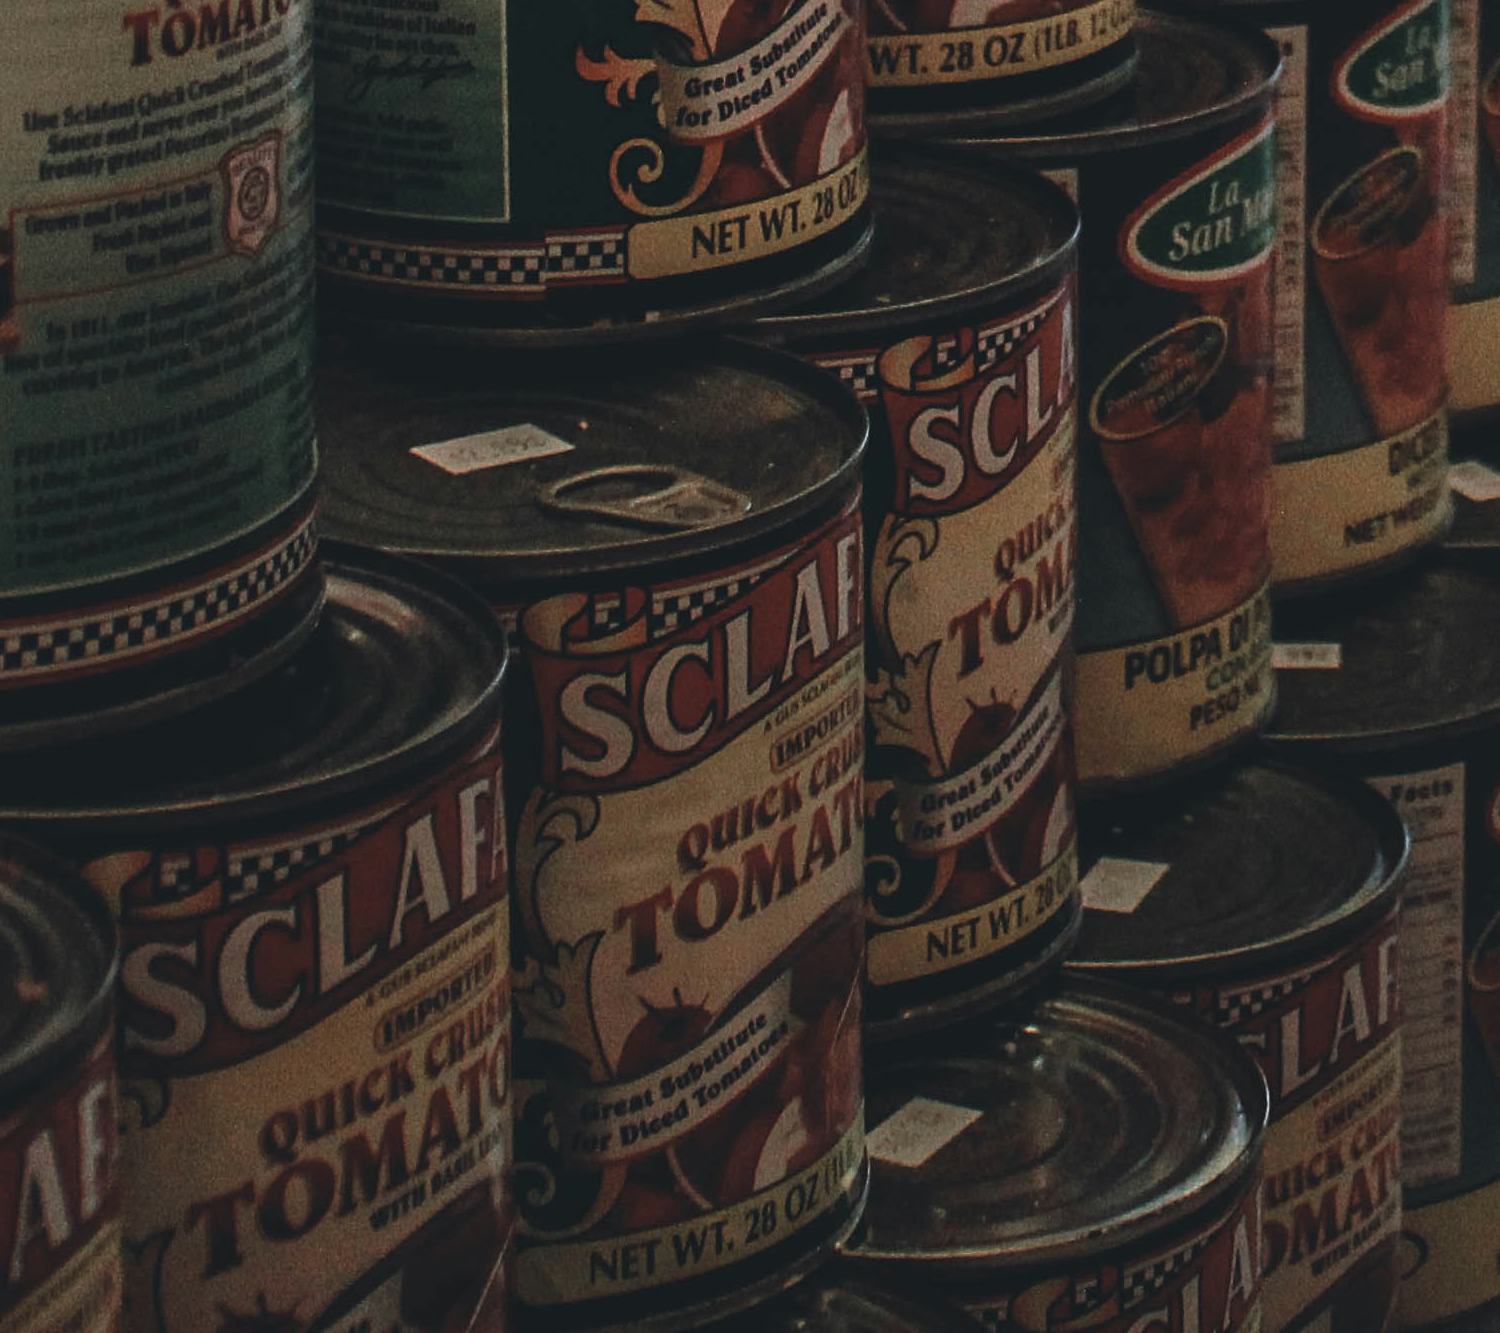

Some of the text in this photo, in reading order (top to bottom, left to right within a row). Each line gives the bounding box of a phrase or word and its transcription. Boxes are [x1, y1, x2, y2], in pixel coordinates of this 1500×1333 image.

[676, 12, 843, 127] for Diced Tomatoes
[684, 4, 827, 98] Great Substitute
[869, 43, 928, 76] WT.
[940, 42, 973, 72] 28
[983, 32, 1026, 65] OZ
[1372, 57, 1427, 100] San
[692, 168, 858, 259] NET WT. 28 OZ
[1166, 216, 1234, 264] San
[1206, 179, 1240, 216] La
[908, 300, 1073, 502] SCL
[948, 540, 1071, 678] TOM
[1124, 608, 1249, 690] POLPA DI
[558, 531, 861, 779] SCLAF
[1189, 686, 1241, 731] PESO
[678, 772, 802, 873] QUICK
[912, 818, 944, 841] for
[950, 790, 1002, 833] Diced
[920, 779, 976, 814] Great
[926, 924, 980, 961] NET
[989, 902, 1029, 937] WT.
[383, 959, 494, 1049] IMPORTED
[1237, 935, 1398, 1098] LAF
[260, 1048, 414, 1162] QUICK
[572, 1021, 790, 1153] for Diced Tomatoes
[580, 1013, 767, 1123] Great Substitute
[187, 1031, 510, 1278] TOMATO
[1262, 1147, 1343, 1203] UICK
[370, 1181, 426, 1228] WITH
[590, 1174, 820, 1285] NET WT. 28 OZ
